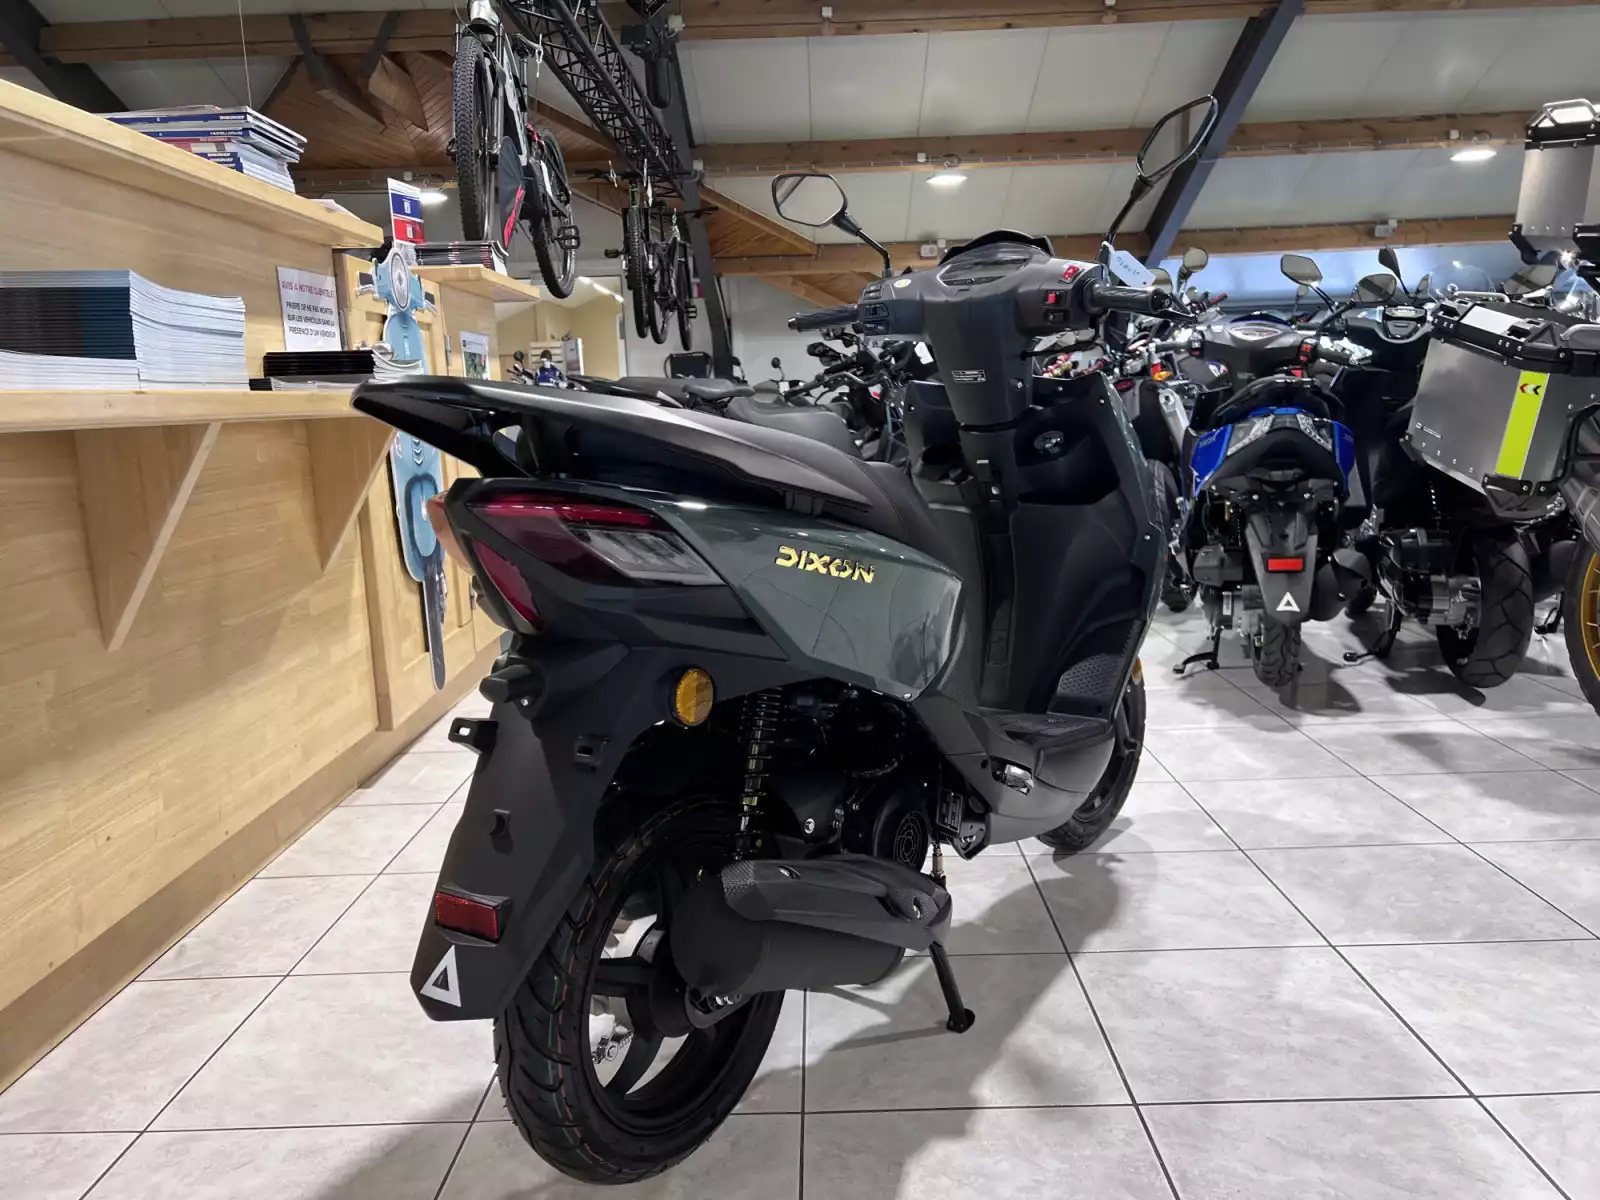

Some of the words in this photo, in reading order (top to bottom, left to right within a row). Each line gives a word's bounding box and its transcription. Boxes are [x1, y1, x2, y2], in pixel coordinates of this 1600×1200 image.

[298, 283, 313, 294] NOTRE
[301, 303, 306, 311] DE
[307, 304, 312, 312] NE
[287, 313, 295, 321] SUR
[775, 545, 876, 584] DIXON
